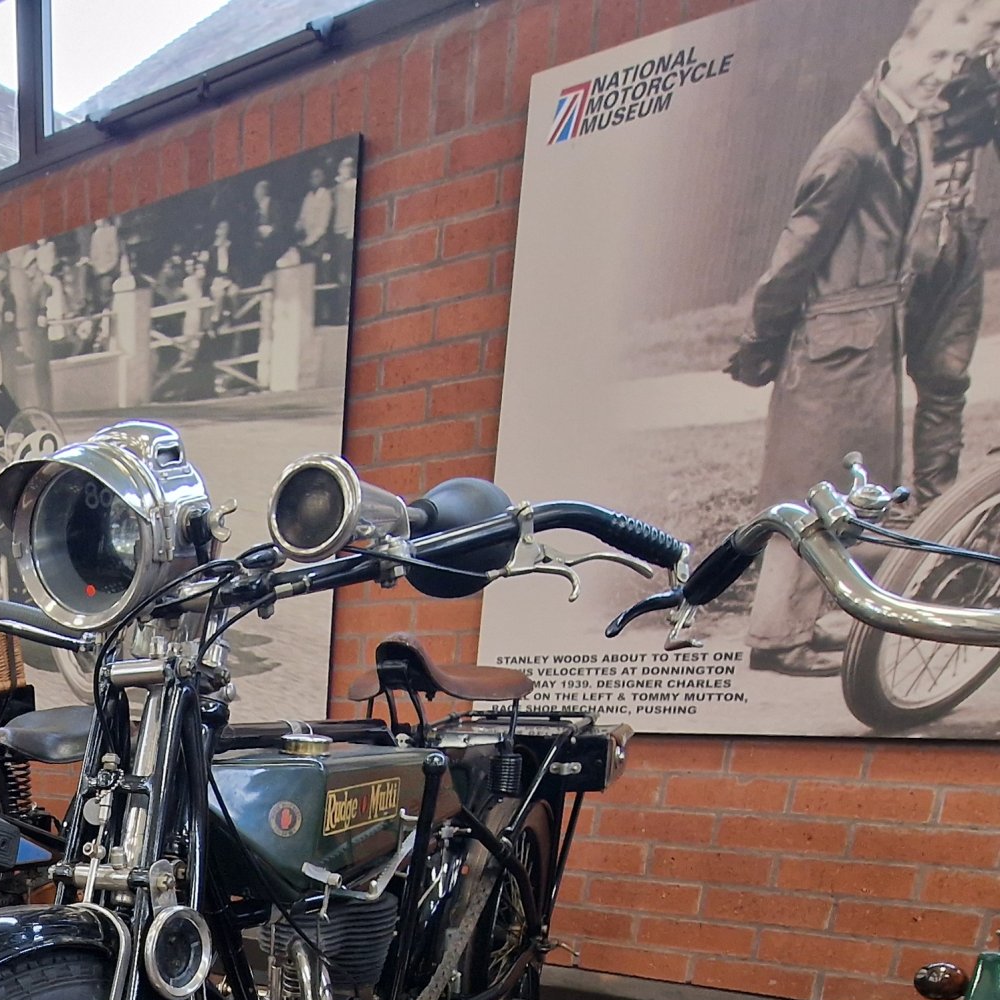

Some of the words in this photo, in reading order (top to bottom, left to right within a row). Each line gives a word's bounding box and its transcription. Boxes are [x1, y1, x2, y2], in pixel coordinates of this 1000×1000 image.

[591, 46, 698, 95] NATIONAL
[585, 53, 735, 116] MOTORCYCLE
[578, 92, 674, 136] MUSEUM
[496, 655, 550, 666] STANLEY
[552, 654, 598, 665] WOODS
[599, 653, 648, 664] ABOUT
[650, 652, 670, 663] TO
[673, 652, 710, 663] TEST
[712, 651, 744, 662] ONE
[536, 666, 618, 677] VELOCETTES
[620, 666, 638, 676] AT
[641, 665, 736, 676] DONNINGTON
[533, 680, 557, 689] MAY
[561, 679, 593, 689] 1939.
[596, 679, 664, 690] DESIGNER
[667, 678, 732, 689] CHARLES
[533, 692, 551, 702] ON
[554, 692, 579, 702] THE
[582, 692, 614, 702] LEFT
[617, 692, 626, 702] &
[631, 692, 680, 702] TOMMY
[683, 692, 748, 704] MUTTON,
[526, 704, 557, 713] SHOP
[561, 705, 632, 715] MECHANIC,
[635, 705, 698, 715] PUSHING
[326, 791, 358, 832] Rudge
[368, 782, 398, 819] Multi
